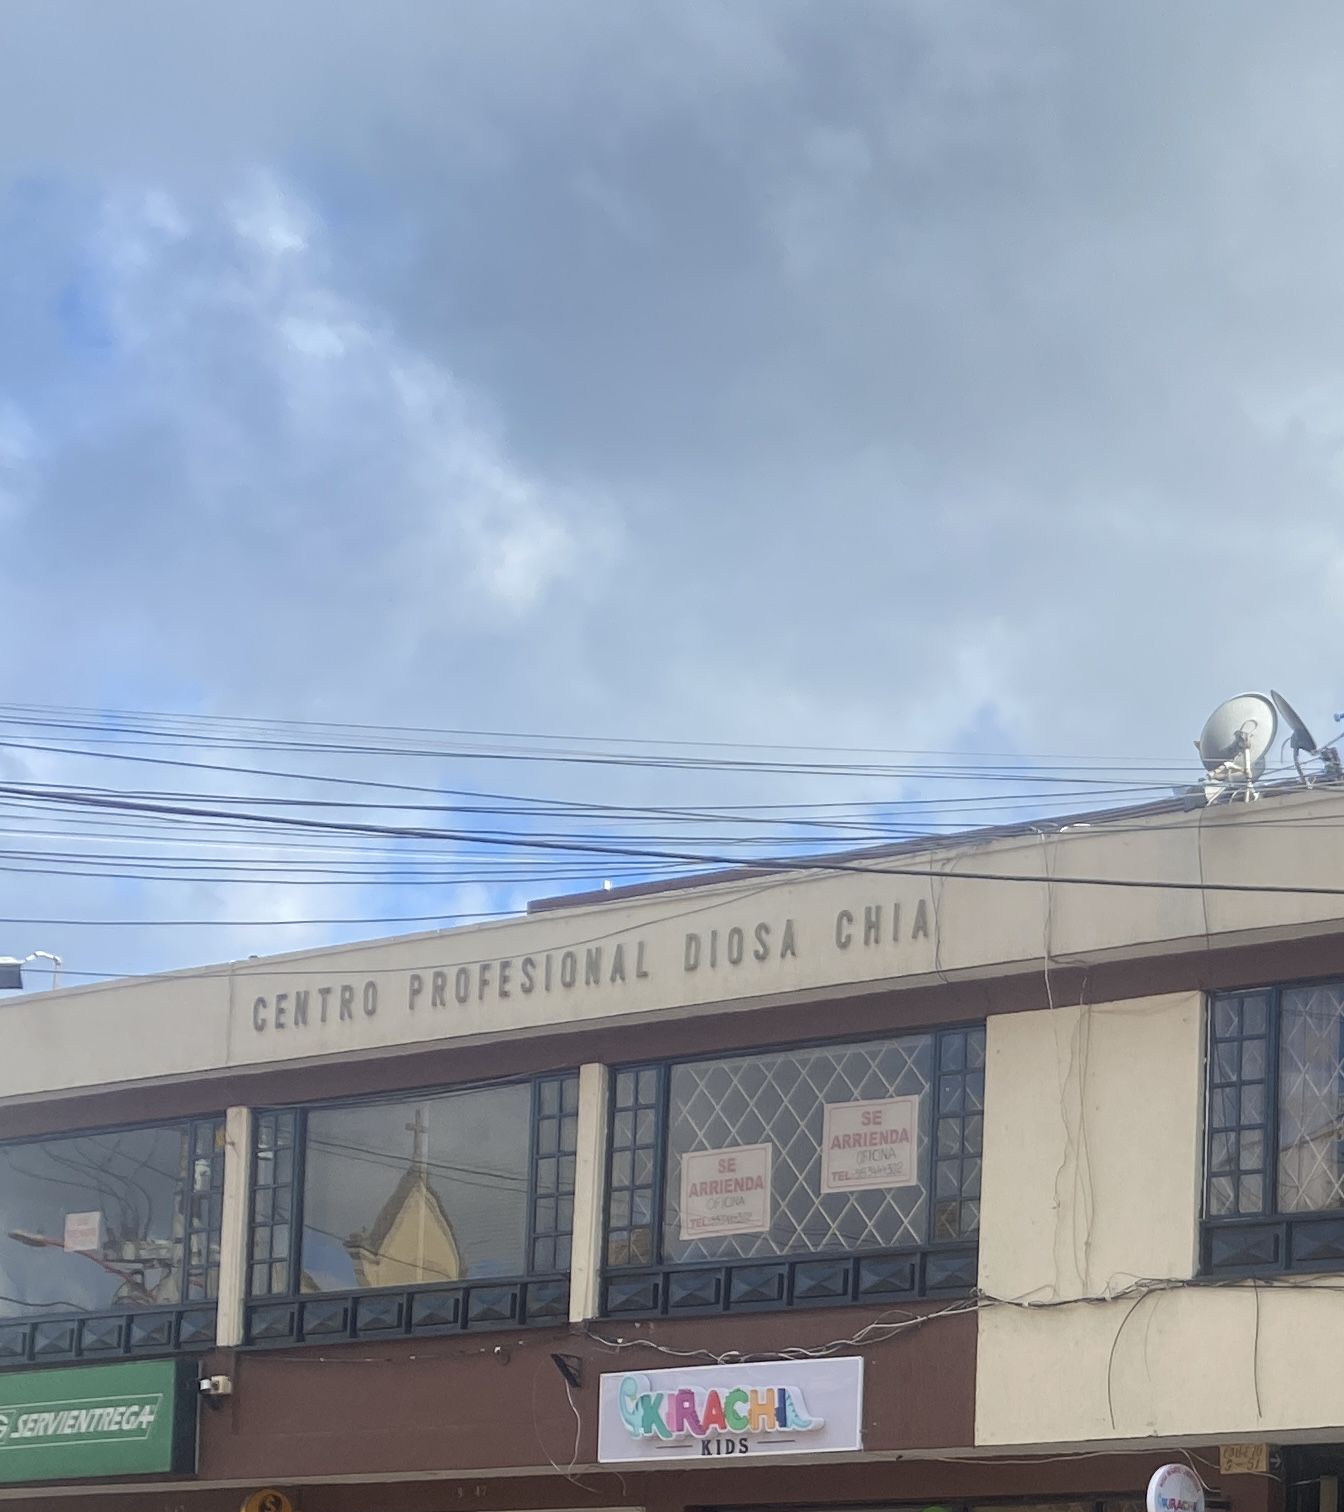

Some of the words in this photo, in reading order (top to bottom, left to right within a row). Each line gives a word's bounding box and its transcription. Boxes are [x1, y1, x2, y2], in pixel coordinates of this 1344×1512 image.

[252, 980, 379, 1033] CENTRO
[408, 941, 650, 1011] PROFESIONAL
[684, 919, 798, 972] DIOSA
[836, 899, 931, 950] CHIA
[861, 1110, 883, 1126] SE
[830, 1128, 910, 1149] ARRIENDA
[718, 1158, 737, 1174] SE
[689, 1175, 765, 1198] ARRIENDA
[10, 1404, 155, 1438] SERVIENTREGA
[640, 1387, 788, 1438] KIRACHI
[701, 1438, 749, 1456] KIDS
